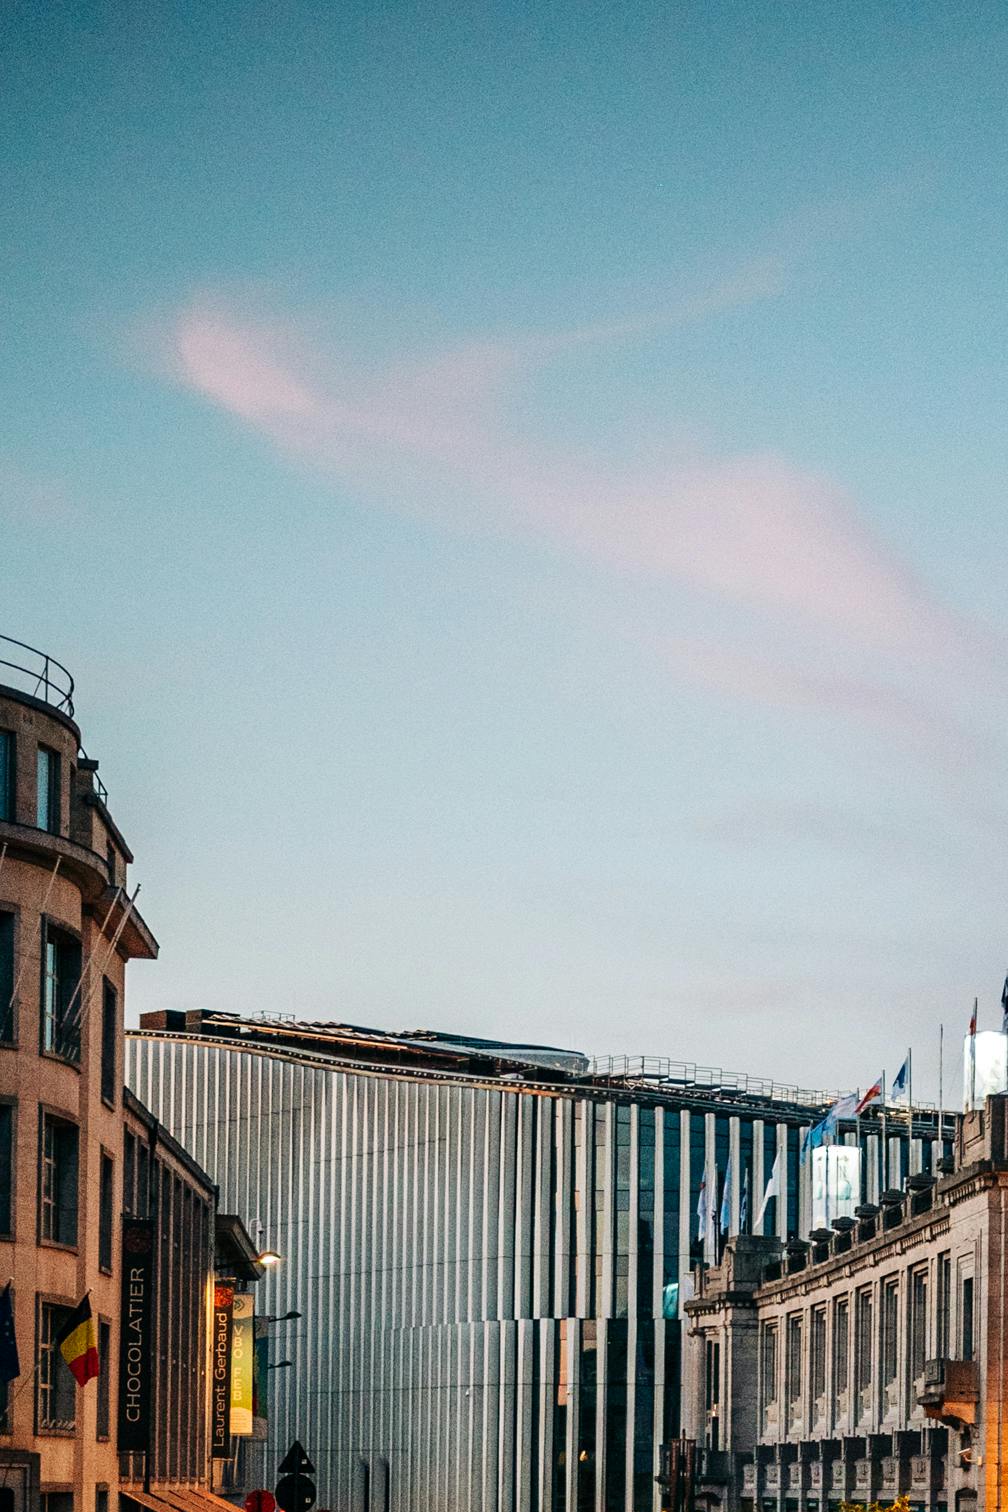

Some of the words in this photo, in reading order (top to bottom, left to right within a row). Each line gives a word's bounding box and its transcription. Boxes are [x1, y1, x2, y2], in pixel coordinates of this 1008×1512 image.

[126, 1267, 145, 1423] CHOCOLATIER
[215, 1313, 228, 1380] Gerbaud
[233, 1326, 244, 1360] VBO
[233, 1368, 242, 1401] FEB
[213, 1386, 226, 1447] Laurent
